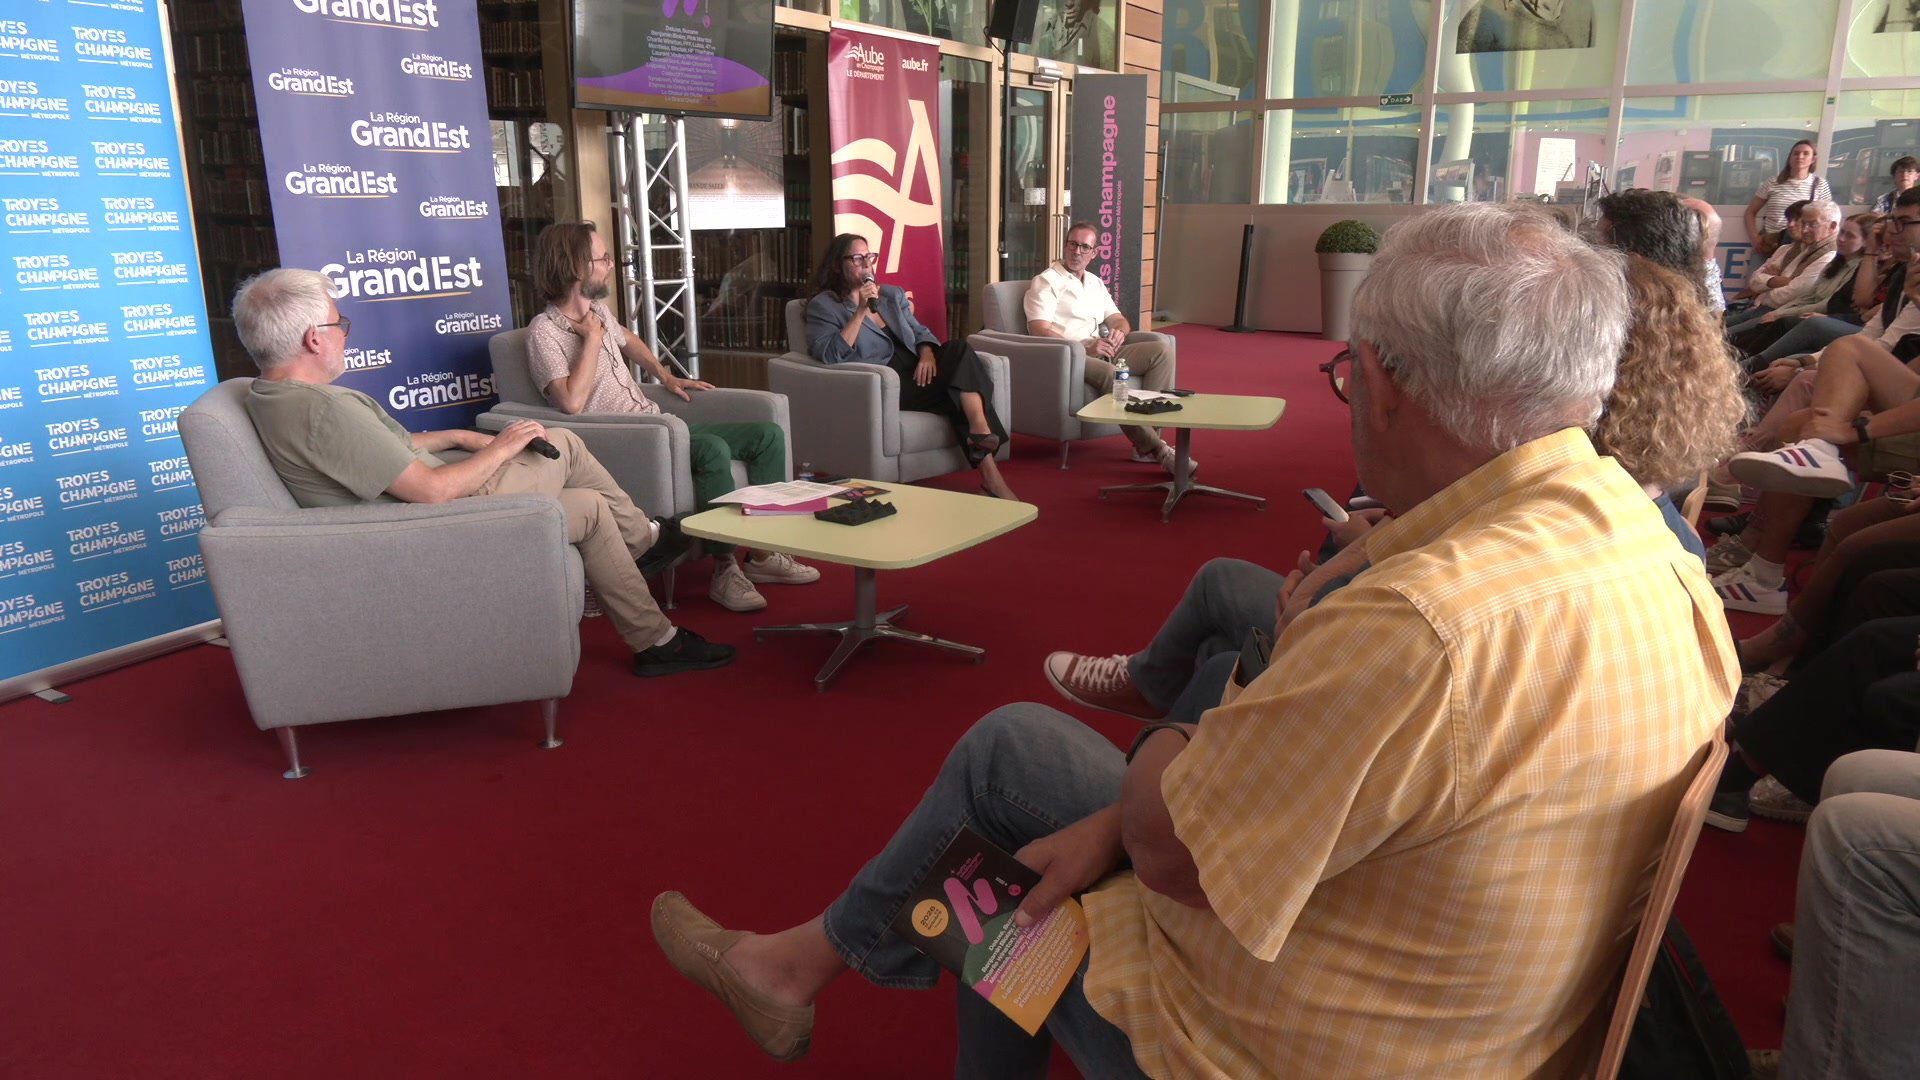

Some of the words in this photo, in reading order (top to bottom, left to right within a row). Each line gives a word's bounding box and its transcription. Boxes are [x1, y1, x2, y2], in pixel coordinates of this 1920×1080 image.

[71, 26, 126, 43] TROYES
[75, 42, 151, 60] CHAMPAGNE
[901, 57, 929, 72] aube.fr
[81, 84, 136, 99] TROYES
[85, 101, 160, 116] CHAMPAGNE
[370, 112, 384, 122] La
[386, 112, 420, 125] Région
[91, 141, 145, 155] TROYES
[95, 157, 169, 170] CHAMPAGNE
[303, 164, 316, 173] La
[318, 163, 351, 174] Région
[1099, 95, 1118, 228] champagne
[3, 198, 59, 211] TROYES
[101, 197, 155, 210] TROYES
[5, 212, 89, 227] CHAMPAGNE
[104, 211, 178, 225] CHAMPAGNE
[1100, 232, 1112, 260] de
[12, 255, 70, 269] TROYES
[111, 251, 164, 265] TROYES
[346, 250, 364, 264] La
[367, 248, 416, 263] Région
[16, 268, 98, 284] CHAMPAGNE
[114, 264, 187, 279] CHAMPAGNE
[24, 310, 80, 326] TROYES
[120, 304, 172, 319] TROYES
[27, 322, 108, 341] CHAMPAGNE
[123, 315, 196, 332] CHAMPAGNE
[129, 355, 181, 372] TROYES
[34, 365, 90, 382] TROYES
[133, 366, 204, 385] CHAMPAGNE
[407, 376, 419, 385] La
[421, 371, 454, 384] Région
[38, 376, 118, 397] CHAMPAGNE
[45, 418, 100, 436] TROYES
[49, 428, 128, 450] CHAMPAGNE
[148, 456, 189, 473] TROYE
[56, 470, 110, 490] TROYES
[59, 479, 137, 504] CHAMPAGNE
[66, 521, 120, 542] TROYES
[69, 529, 147, 556] CHAMPAGNE
[76, 572, 129, 593] TROYES
[80, 579, 155, 607] CHAMPAGNE
